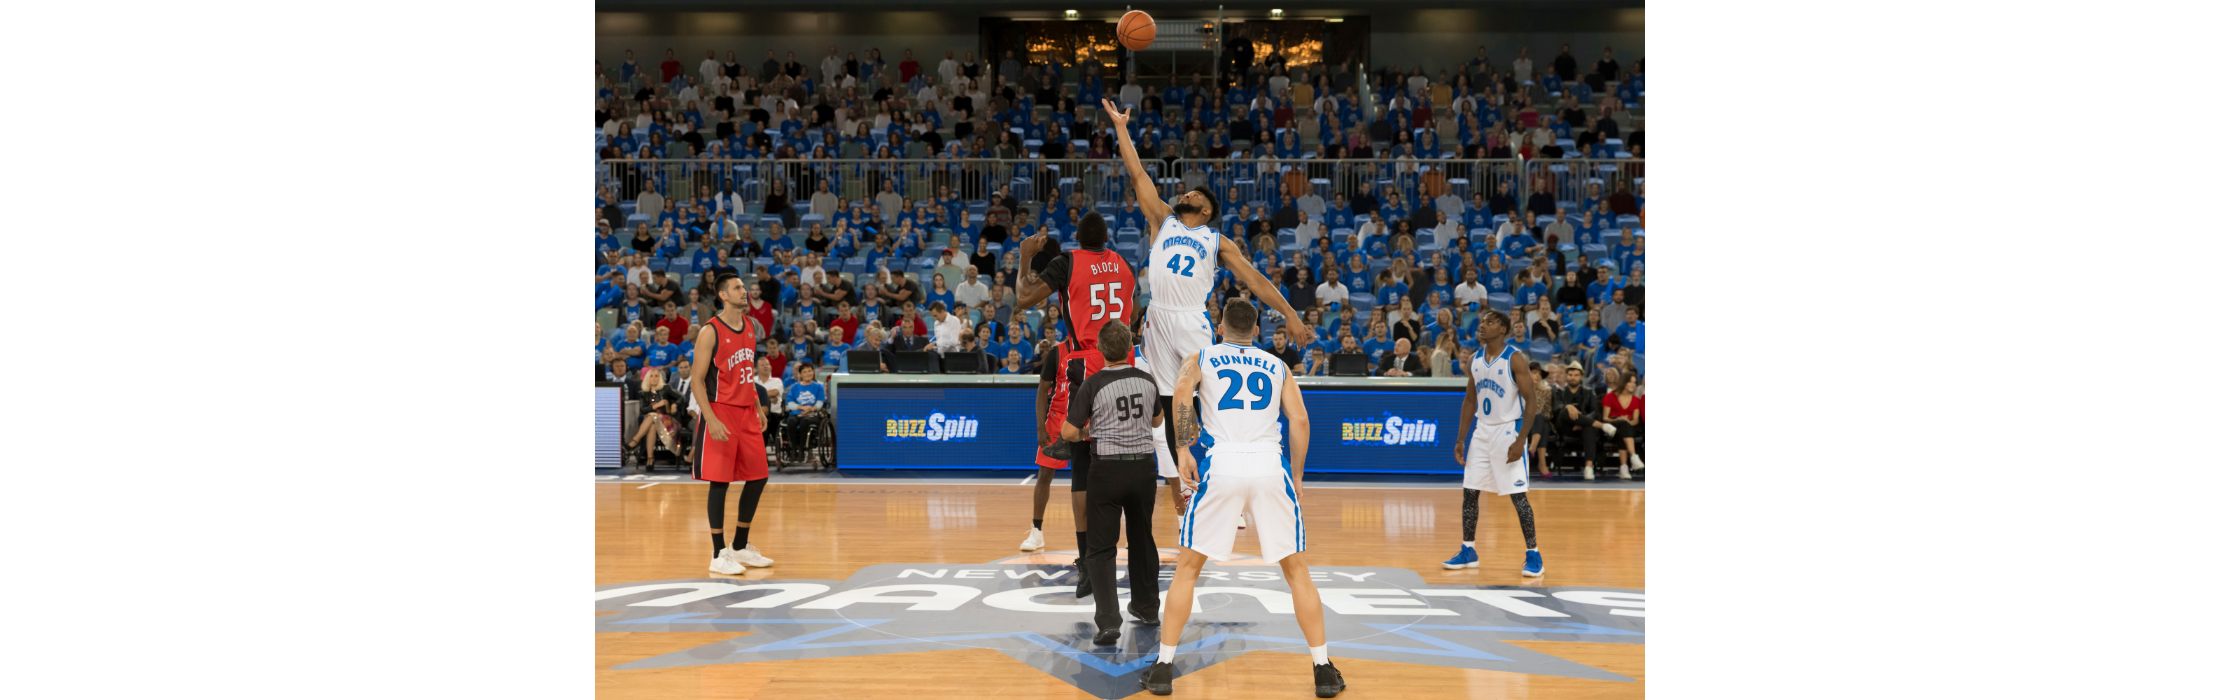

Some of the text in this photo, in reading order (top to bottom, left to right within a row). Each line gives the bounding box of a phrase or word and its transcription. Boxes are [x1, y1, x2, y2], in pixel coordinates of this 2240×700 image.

[1163, 235, 1207, 260] MAGNETS
[1090, 261, 1119, 276] BLOCK
[1166, 253, 1196, 278] 42
[1089, 281, 1124, 321] 55
[739, 366, 754, 385] 32
[1209, 354, 1276, 375] BUNNELL
[1216, 368, 1273, 411] 29
[1115, 392, 1143, 421] 95
[1482, 397, 1492, 416] 0
[897, 568, 1070, 580] NEW
